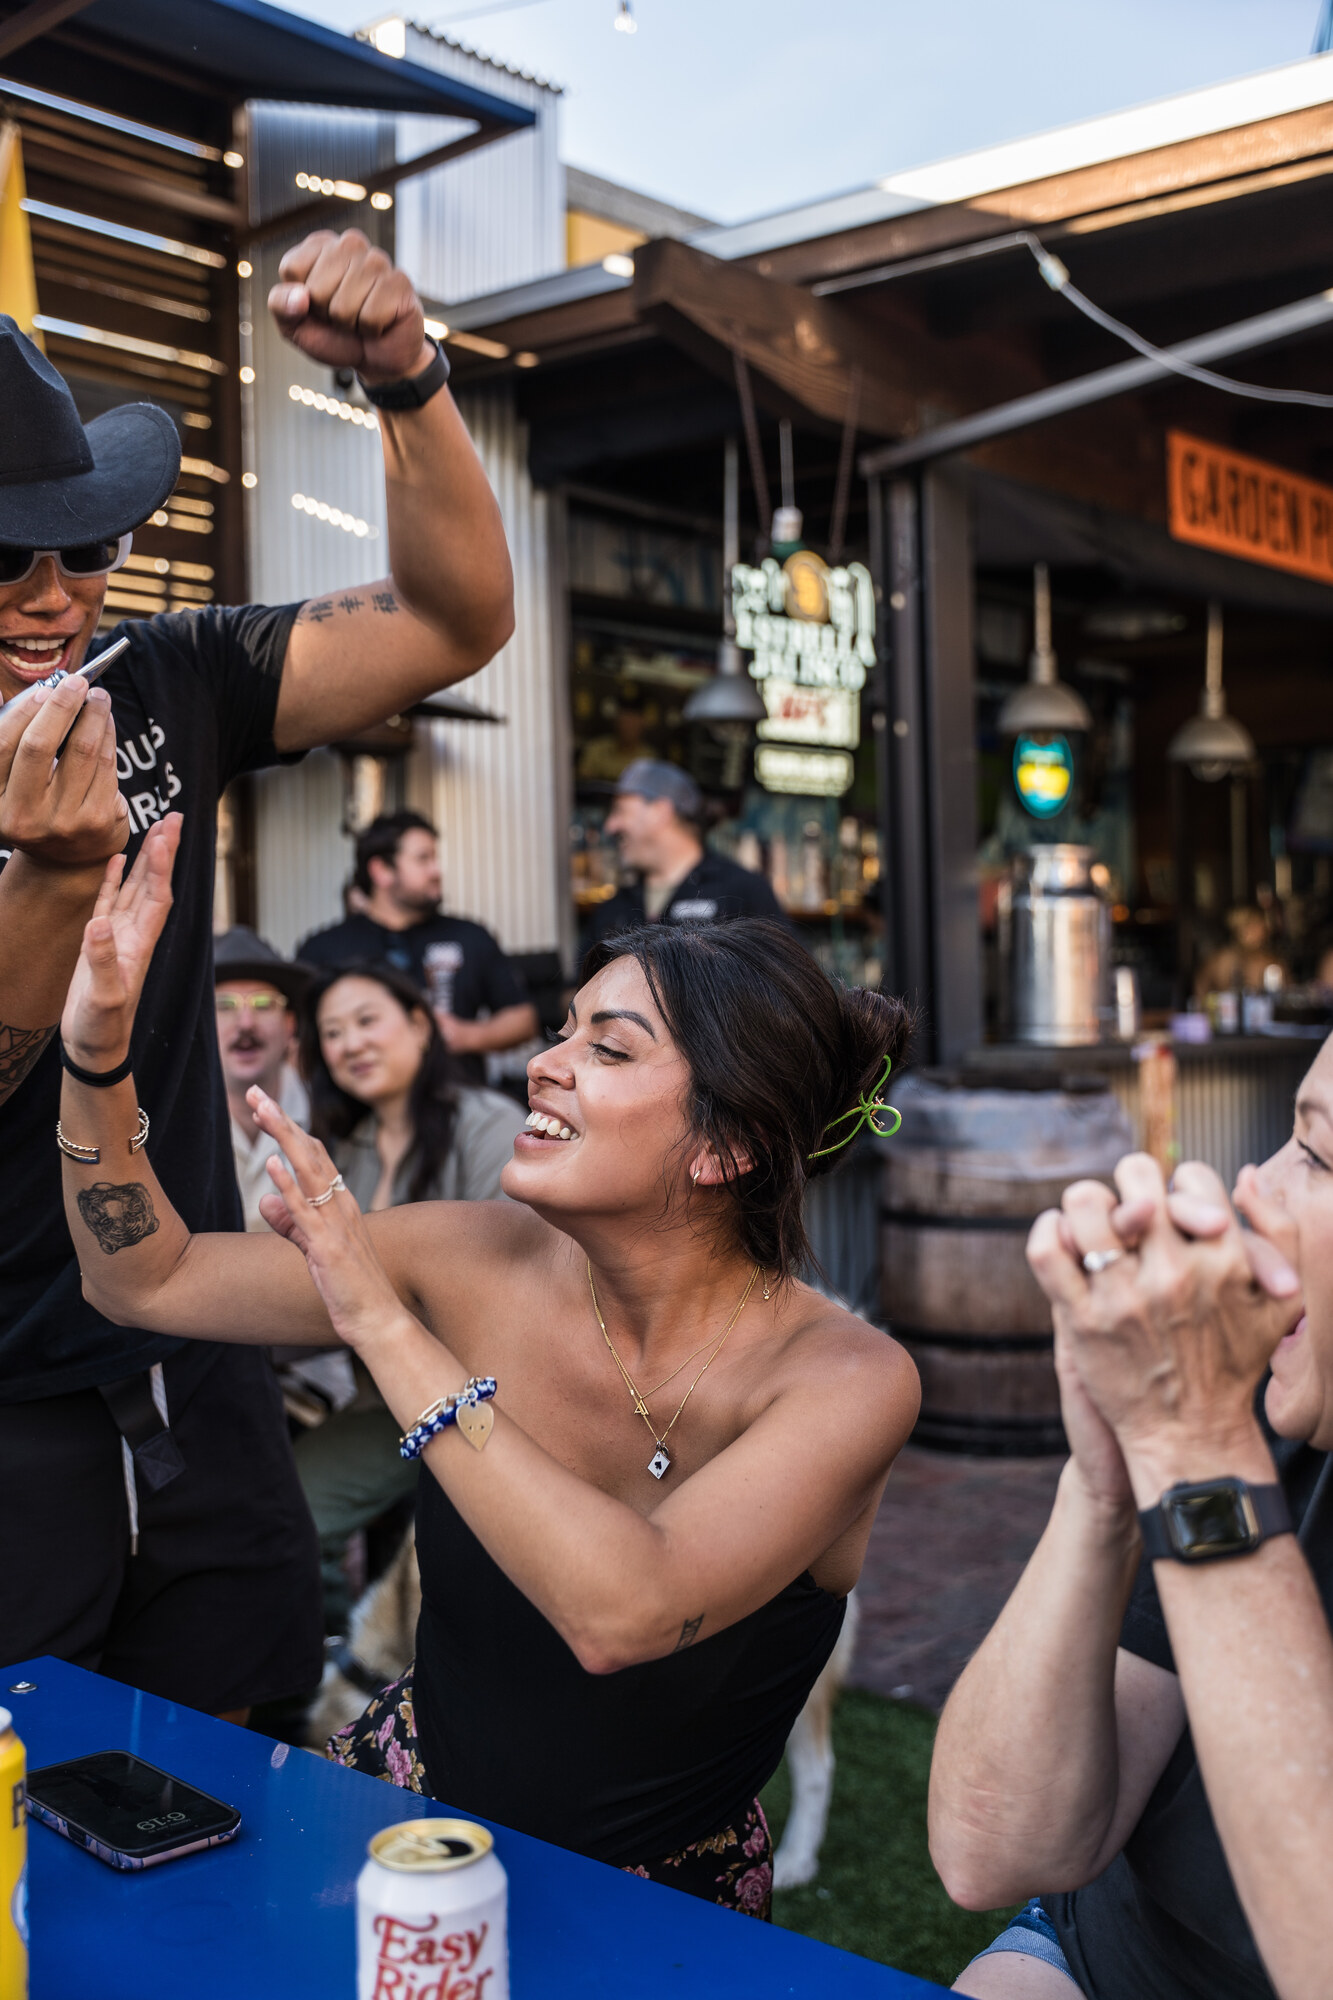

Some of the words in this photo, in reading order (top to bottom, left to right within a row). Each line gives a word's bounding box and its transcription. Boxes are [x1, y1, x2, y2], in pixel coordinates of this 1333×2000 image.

[1181, 452, 1302, 557] GARDEN
[296, 592, 399, 624] 情幸福
[137, 1812, 186, 1831] 6:19
[374, 1913, 488, 1973] Easy
[372, 1962, 493, 2000] Rider
